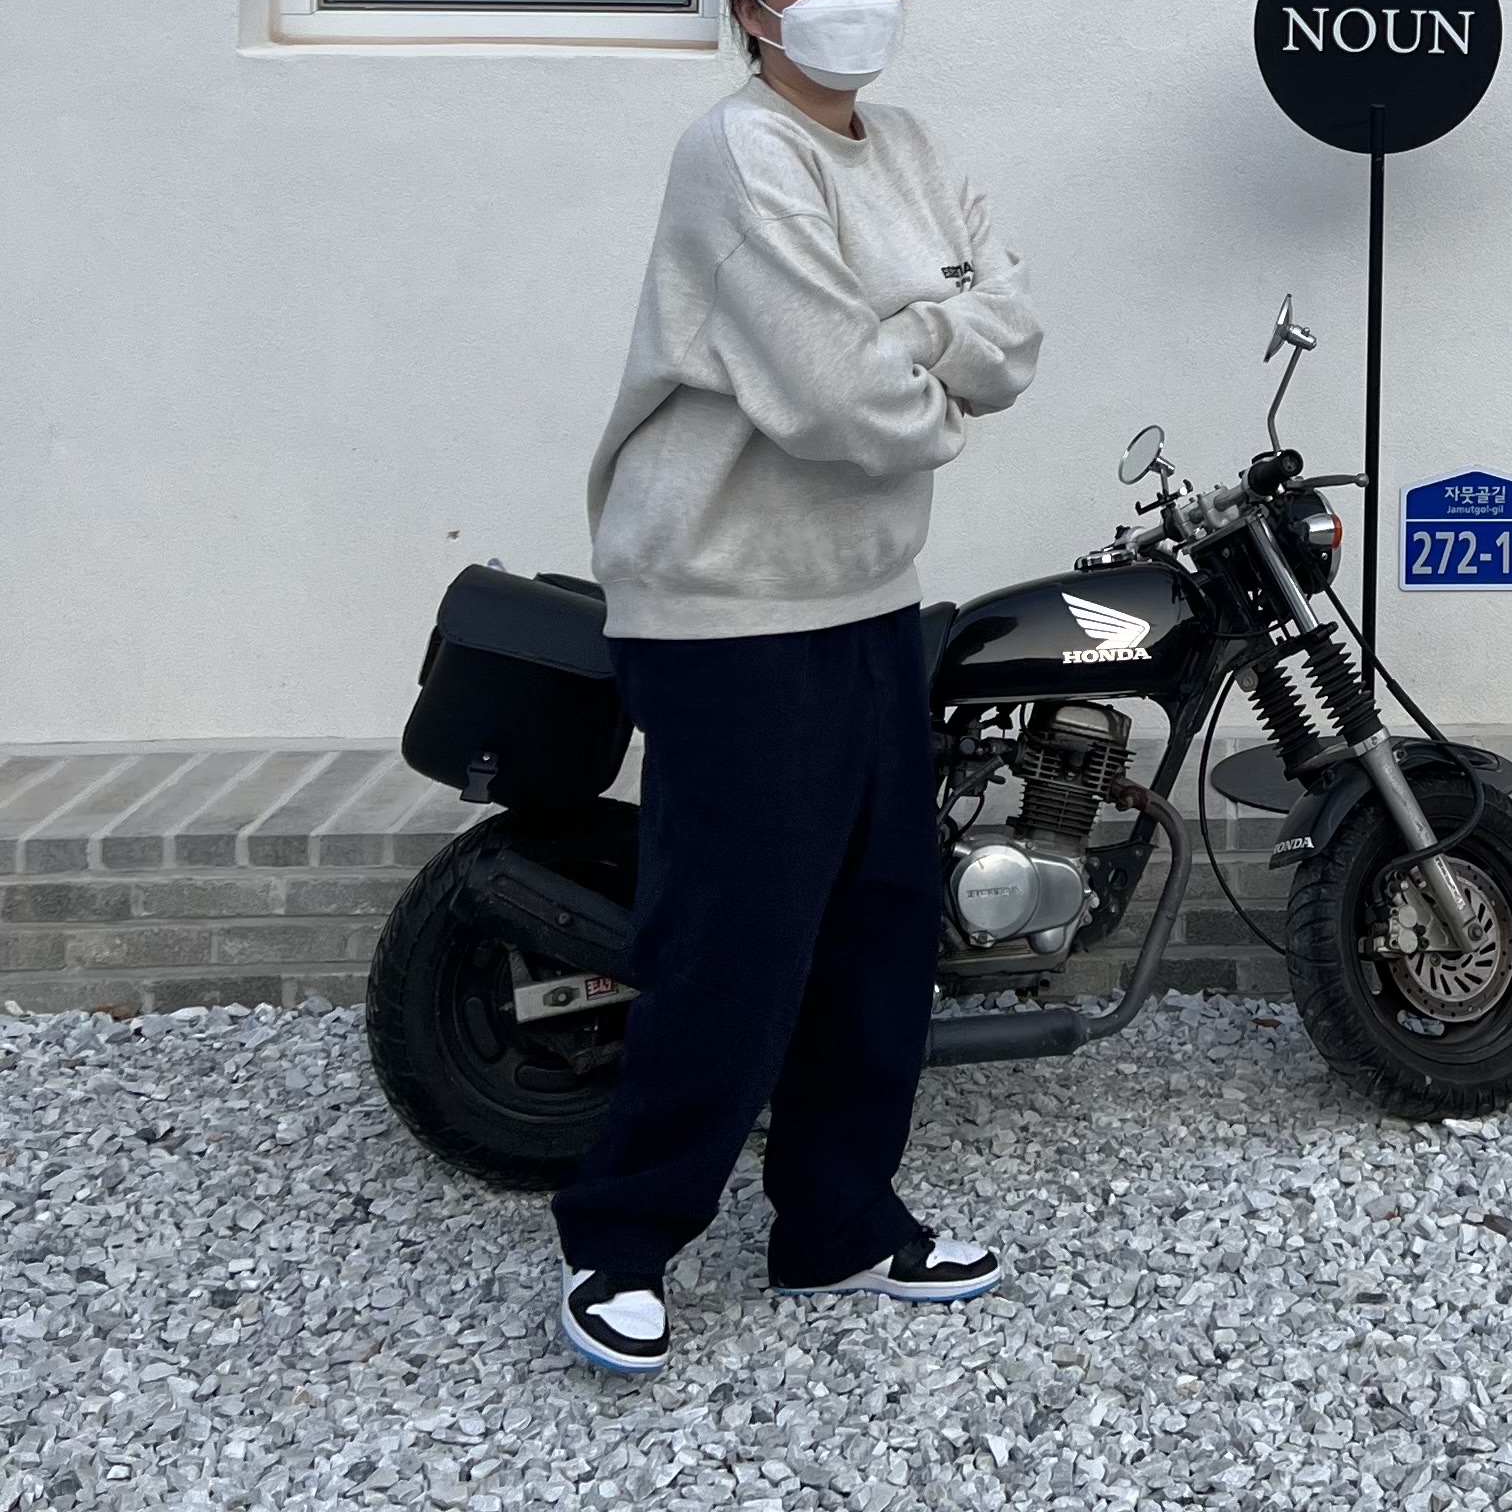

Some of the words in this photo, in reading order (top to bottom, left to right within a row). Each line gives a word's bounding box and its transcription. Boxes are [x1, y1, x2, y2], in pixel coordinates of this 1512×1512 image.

[1281, 7, 1476, 55] NOUN
[1444, 485, 1507, 504] 자뭇골길
[1446, 505, 1504, 516] Jamutgol-gil
[1062, 647, 1152, 664] HONDA
